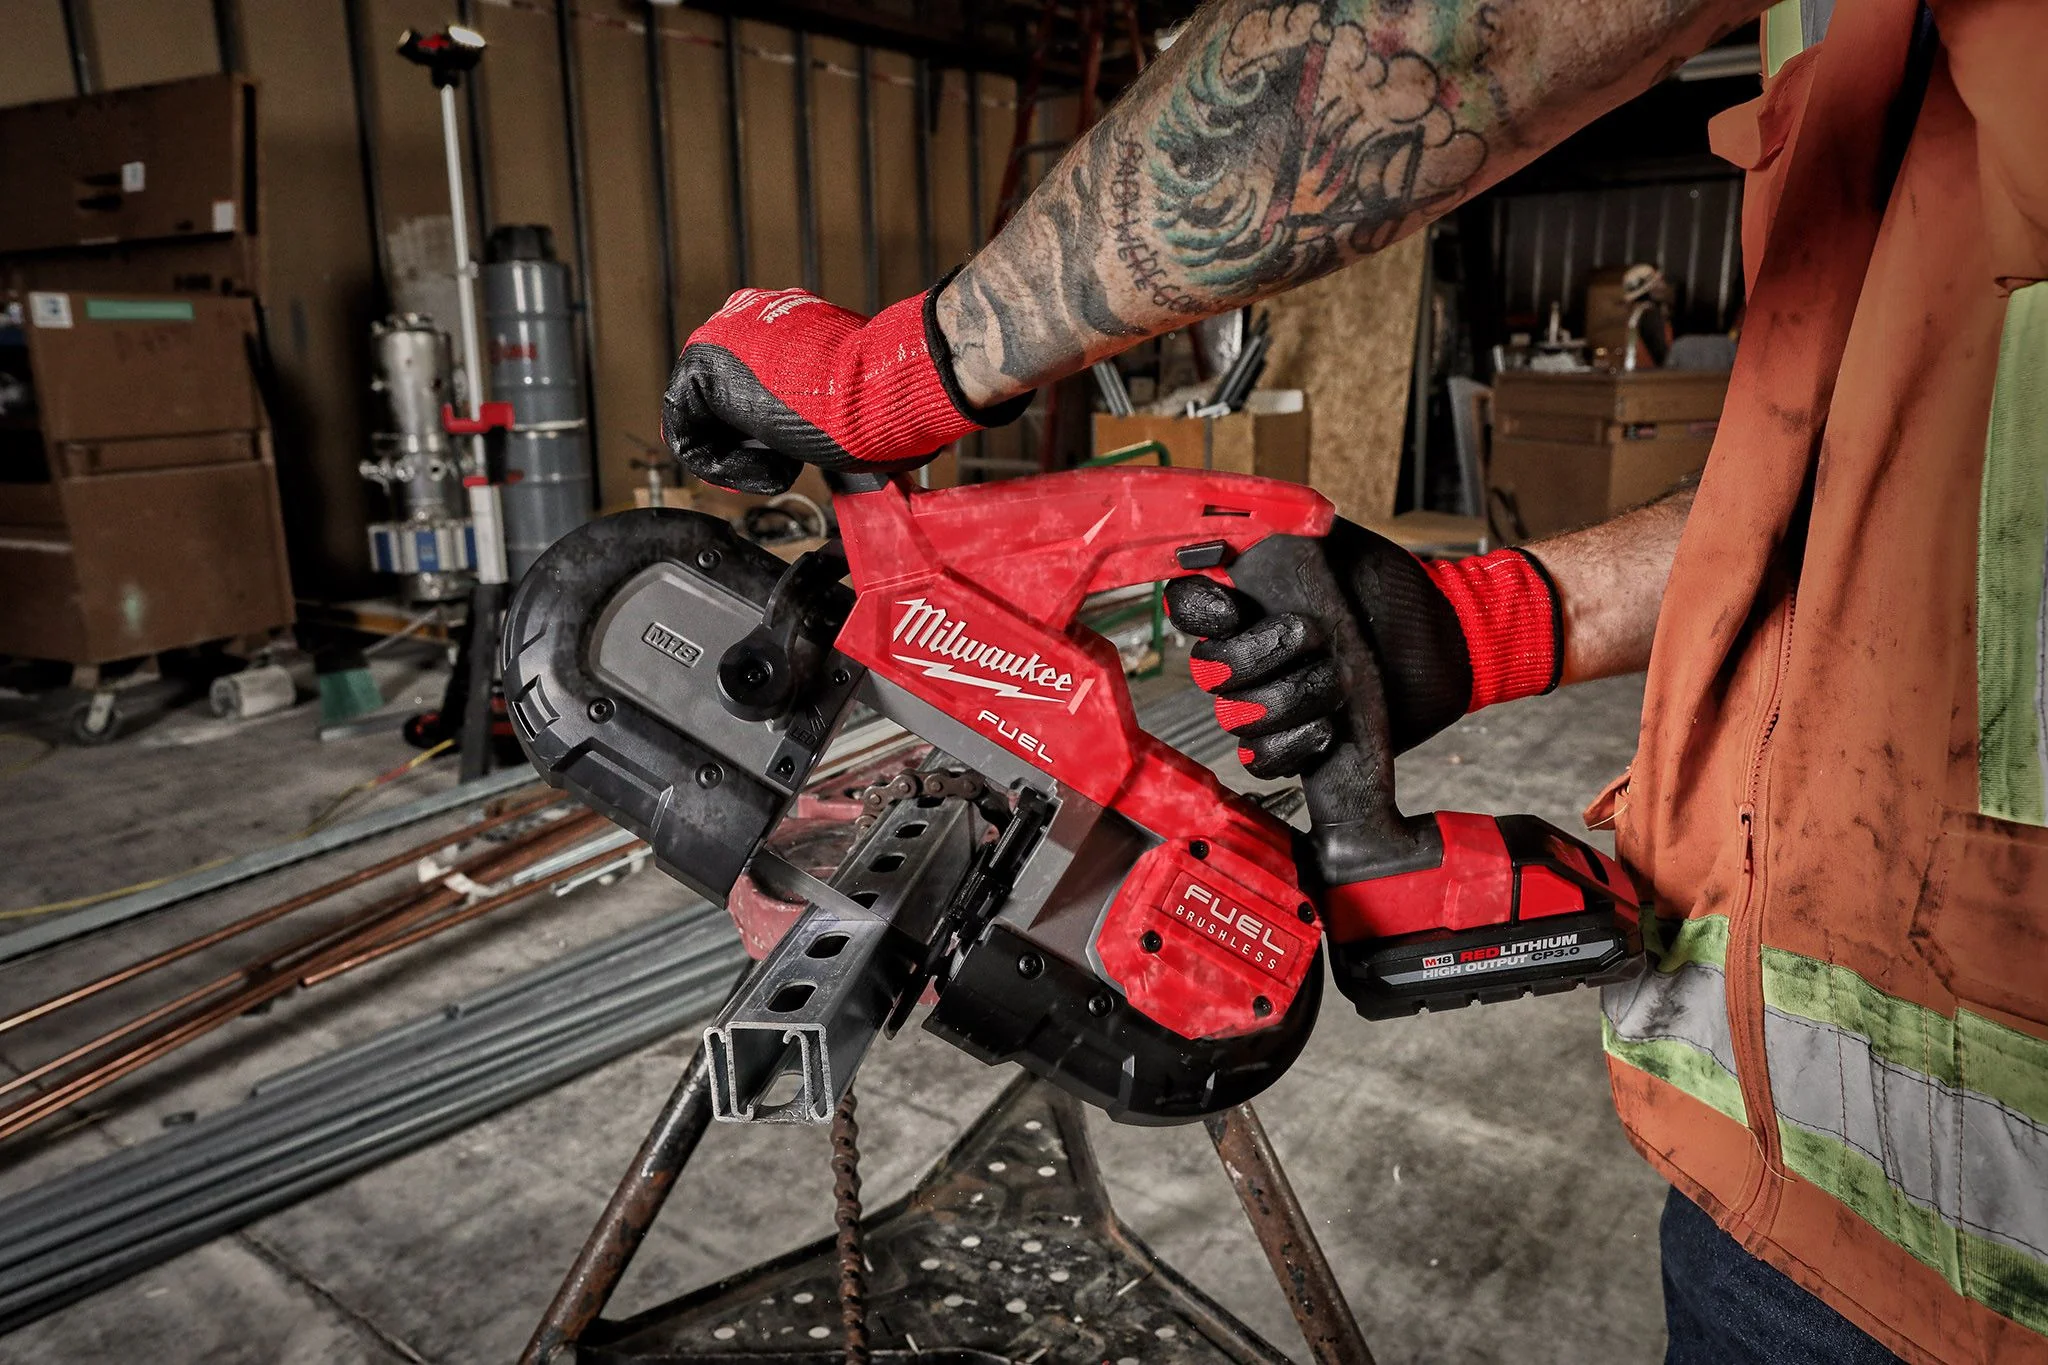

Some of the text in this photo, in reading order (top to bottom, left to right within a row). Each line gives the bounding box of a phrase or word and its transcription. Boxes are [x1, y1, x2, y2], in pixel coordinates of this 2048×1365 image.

[645, 625, 701, 663] M18
[892, 598, 1073, 691] Milwaukee
[977, 709, 1054, 764] FUEL
[1176, 904, 1276, 969] BRUSHLESS
[1184, 884, 1284, 955] FUEL
[1422, 946, 1579, 979] HIGH OUTPUT CP3.0
[1424, 933, 1578, 968] M18 REDLITHIUM
